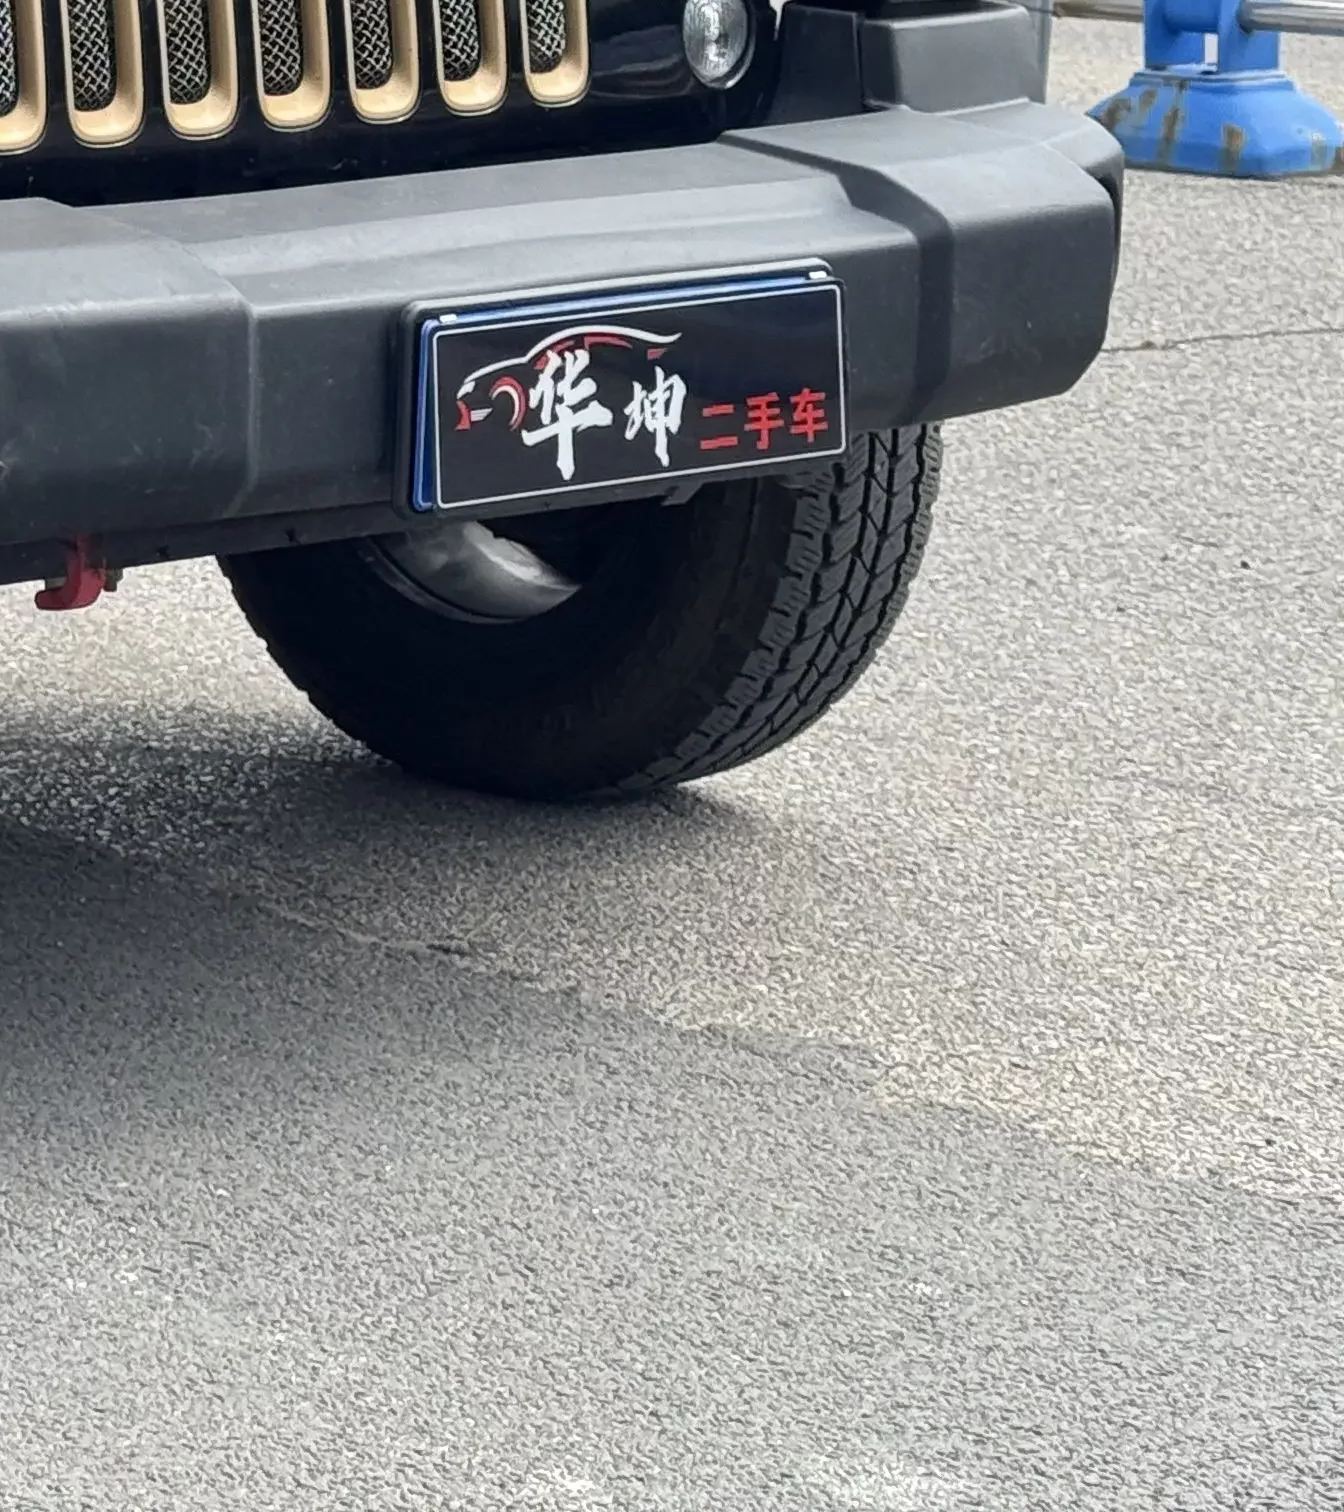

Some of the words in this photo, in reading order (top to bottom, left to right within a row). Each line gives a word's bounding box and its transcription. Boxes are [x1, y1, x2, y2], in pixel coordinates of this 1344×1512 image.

[520, 349, 688, 481] 华坤
[699, 387, 830, 451] 二手车
